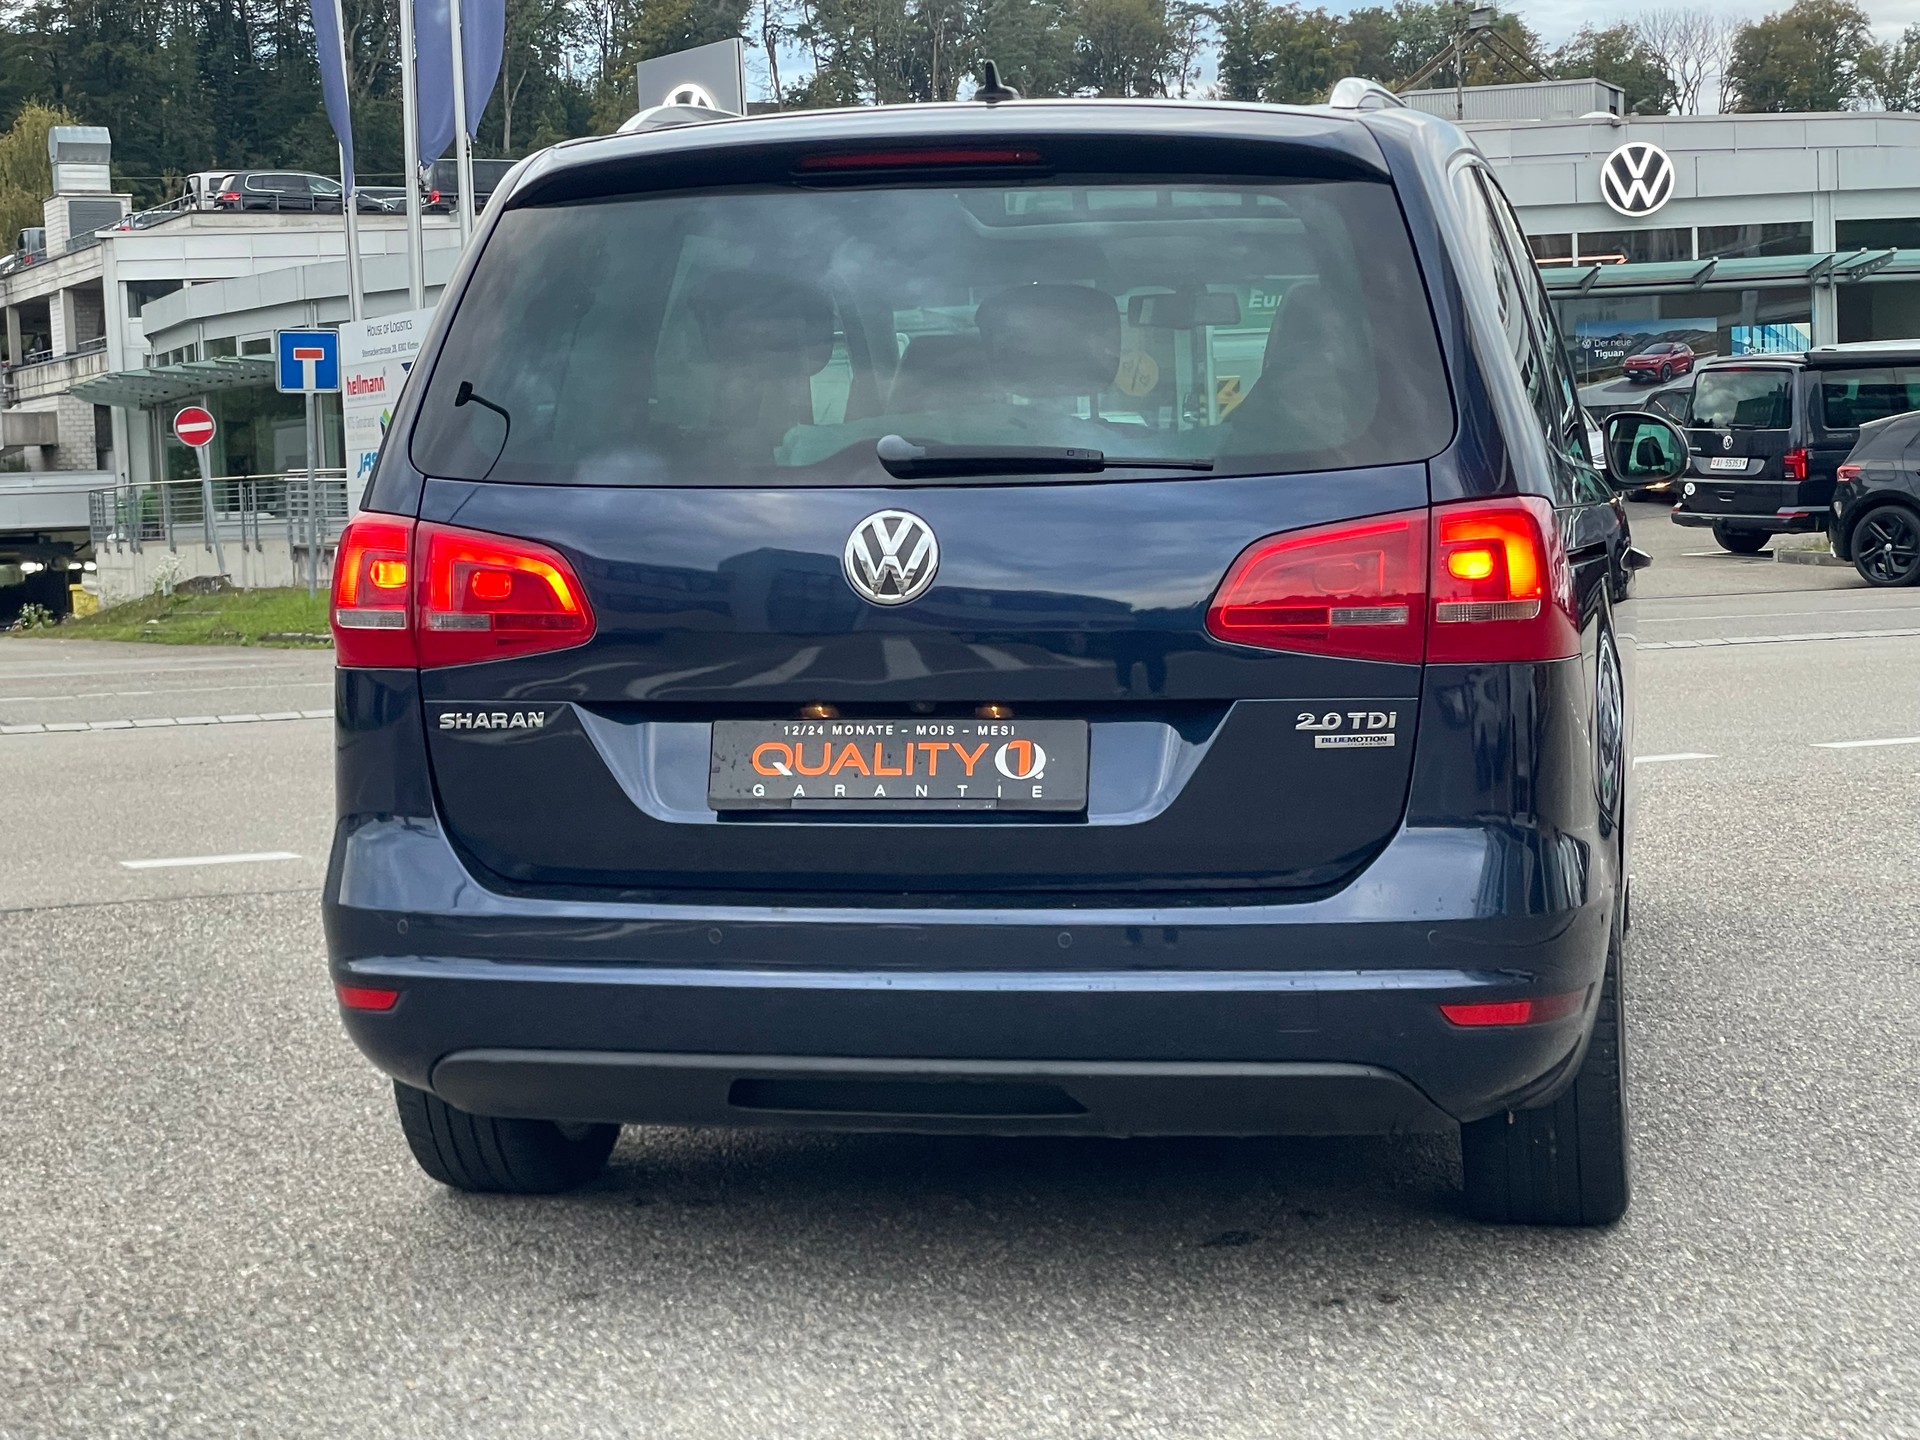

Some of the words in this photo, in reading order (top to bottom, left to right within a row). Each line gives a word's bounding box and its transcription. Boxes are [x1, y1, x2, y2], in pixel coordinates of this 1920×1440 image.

[1601, 142, 1675, 217] VW
[1594, 340, 1609, 348] Der
[1610, 339, 1632, 347] neue
[1594, 350, 1624, 359] Tiguan
[346, 374, 385, 396] hellmann
[844, 509, 939, 606] VW
[439, 711, 545, 729] SHARAN
[783, 725, 825, 736] 12/24
[832, 725, 894, 736] MONATE
[916, 725, 955, 736] MOIS
[977, 725, 1015, 736] MESI
[1321, 735, 1388, 744] BLUEMOTION
[752, 742, 990, 777] QUALITY
[752, 784, 1043, 798] GARANTIE
